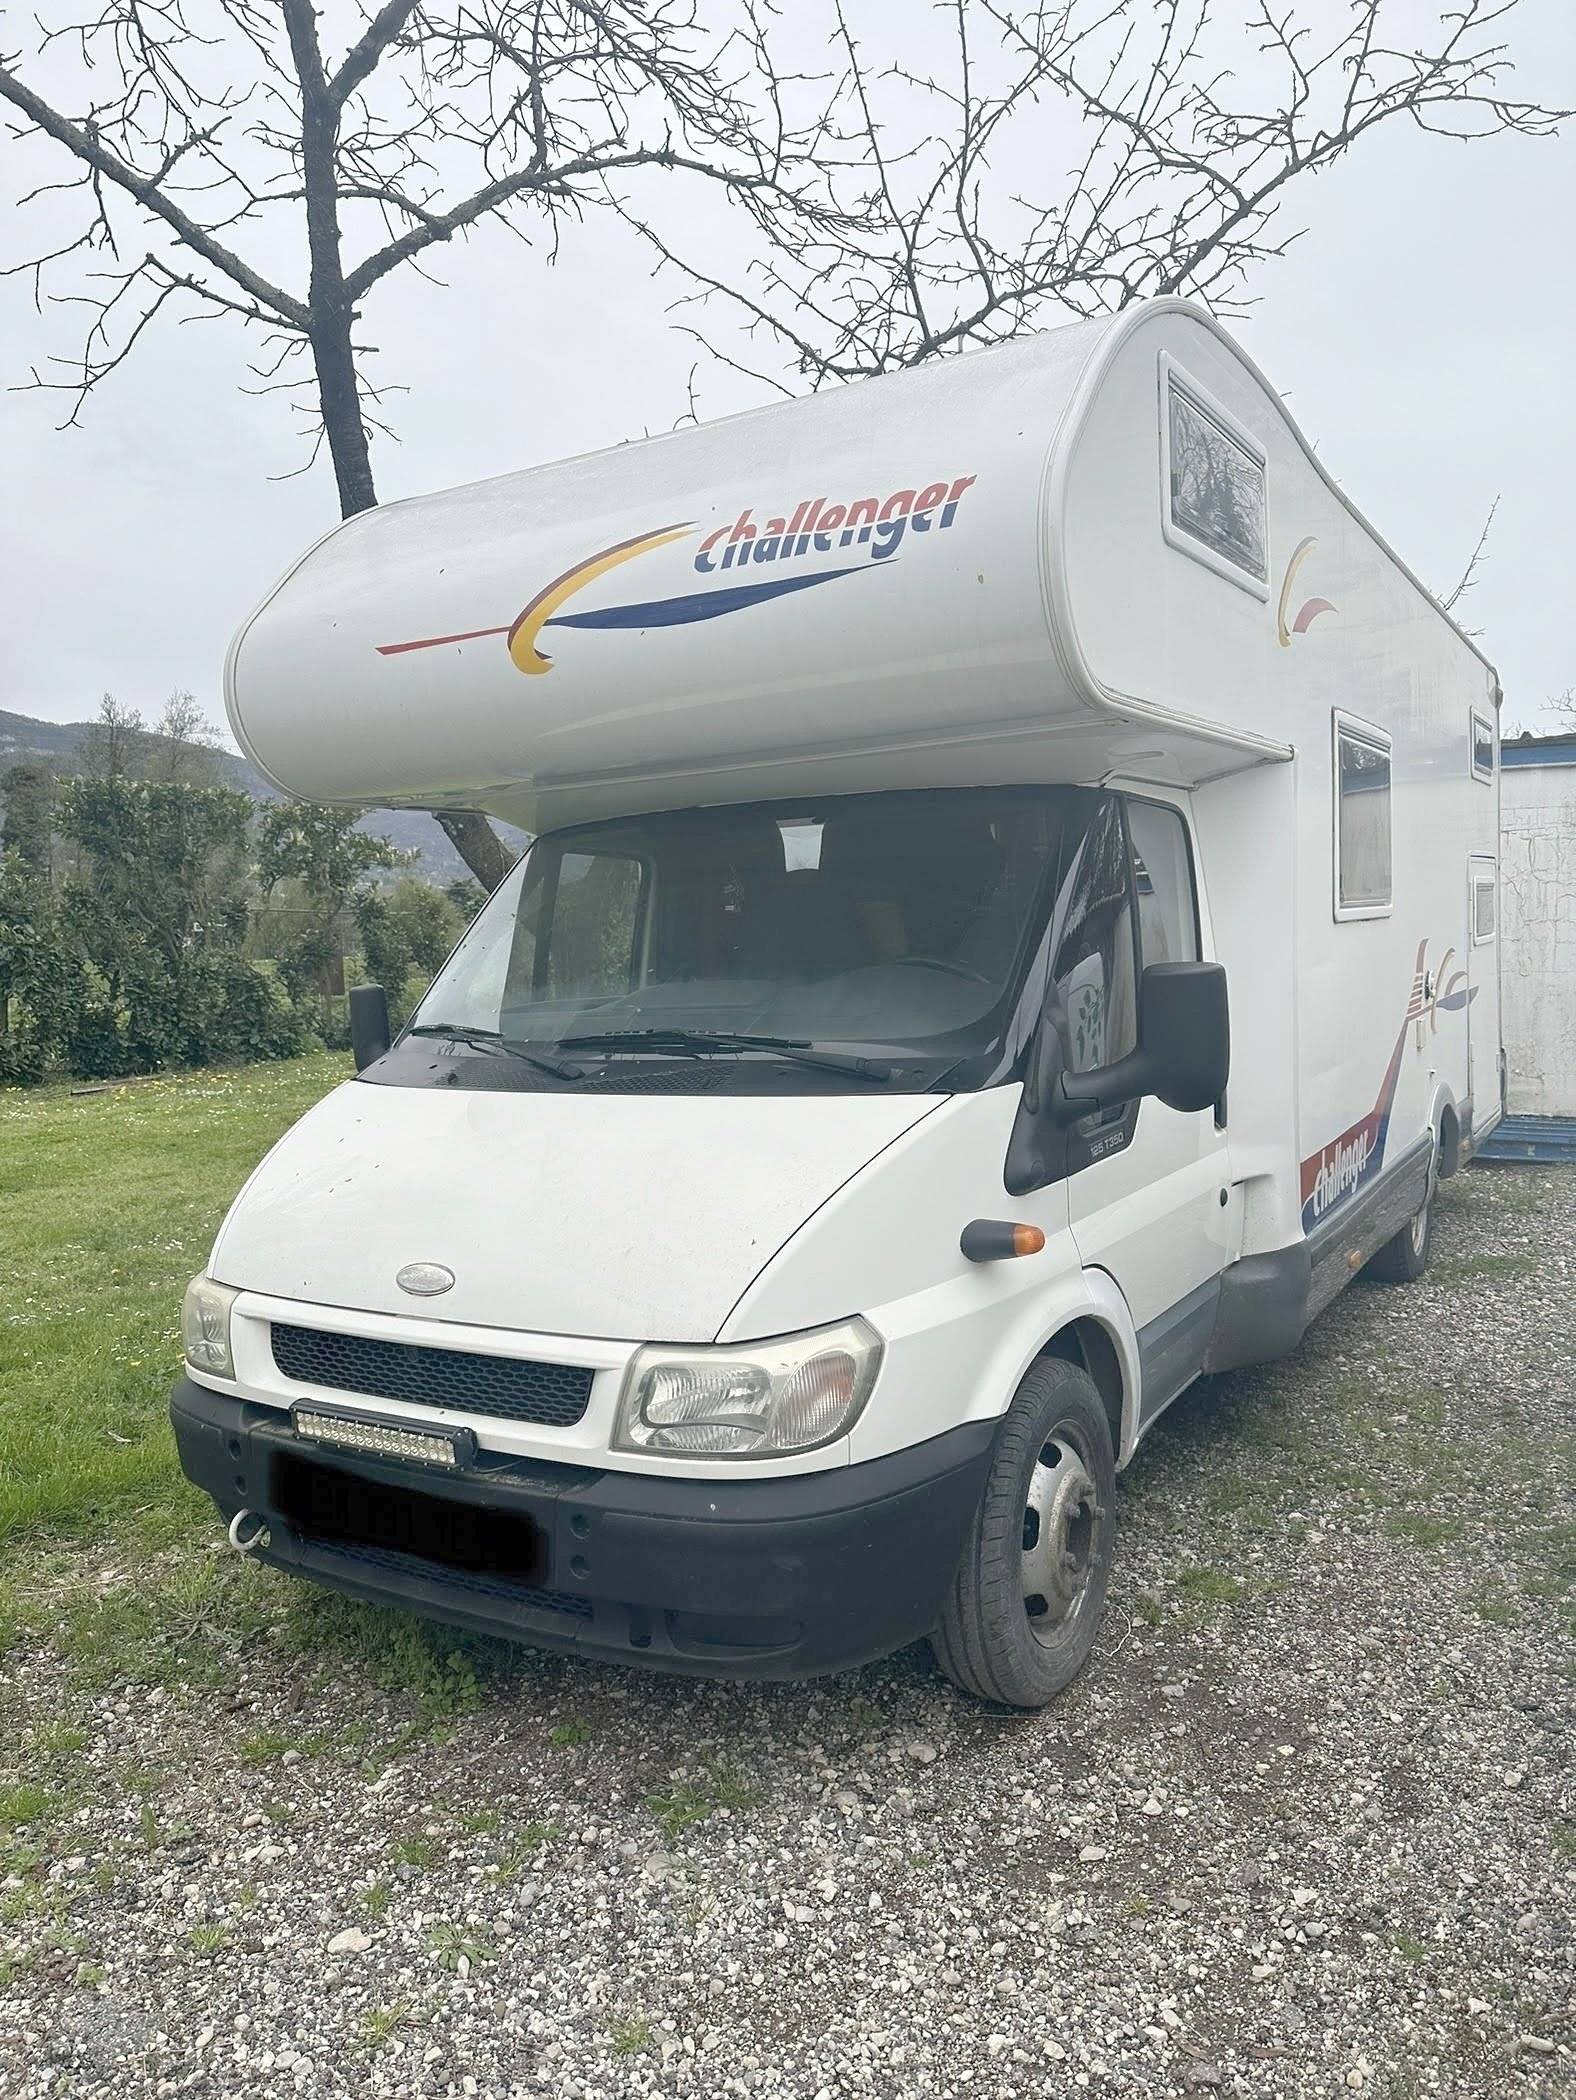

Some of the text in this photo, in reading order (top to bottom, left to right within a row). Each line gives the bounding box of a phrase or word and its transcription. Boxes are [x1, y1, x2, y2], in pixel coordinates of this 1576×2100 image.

[694, 474, 977, 573] challenger
[1090, 1131, 1124, 1157] 125 T350
[1313, 1129, 1369, 1216] challenger
